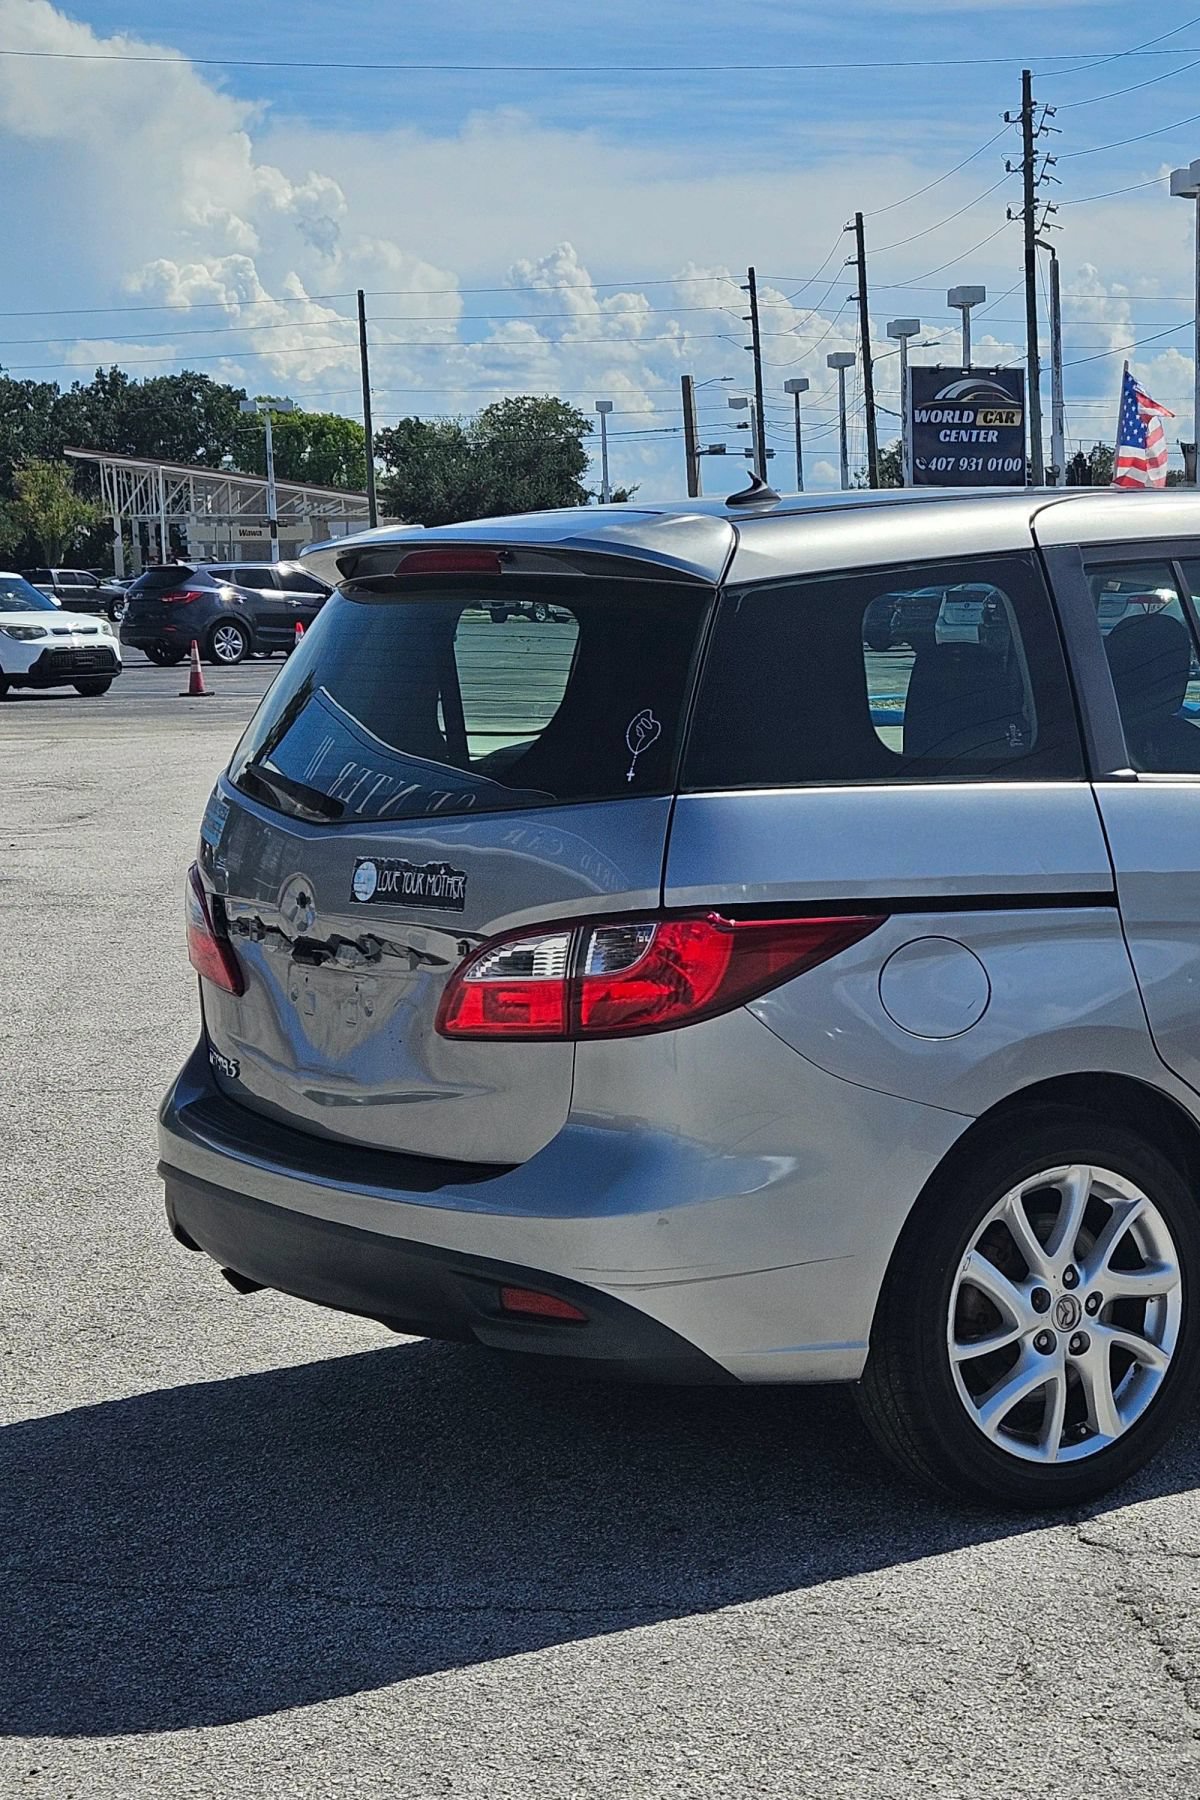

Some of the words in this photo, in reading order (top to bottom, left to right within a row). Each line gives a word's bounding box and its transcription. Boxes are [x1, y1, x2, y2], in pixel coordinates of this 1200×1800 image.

[914, 409, 975, 424] WORLD
[982, 410, 1016, 424] CAR
[939, 429, 999, 443] CENTER
[928, 457, 955, 471] 407
[958, 457, 983, 471] 931
[987, 457, 1022, 472] 0100
[239, 529, 262, 537] Wawa
[376, 870, 401, 893] LOVE
[401, 871, 425, 895] YOUR
[425, 874, 466, 900] MOTHER
